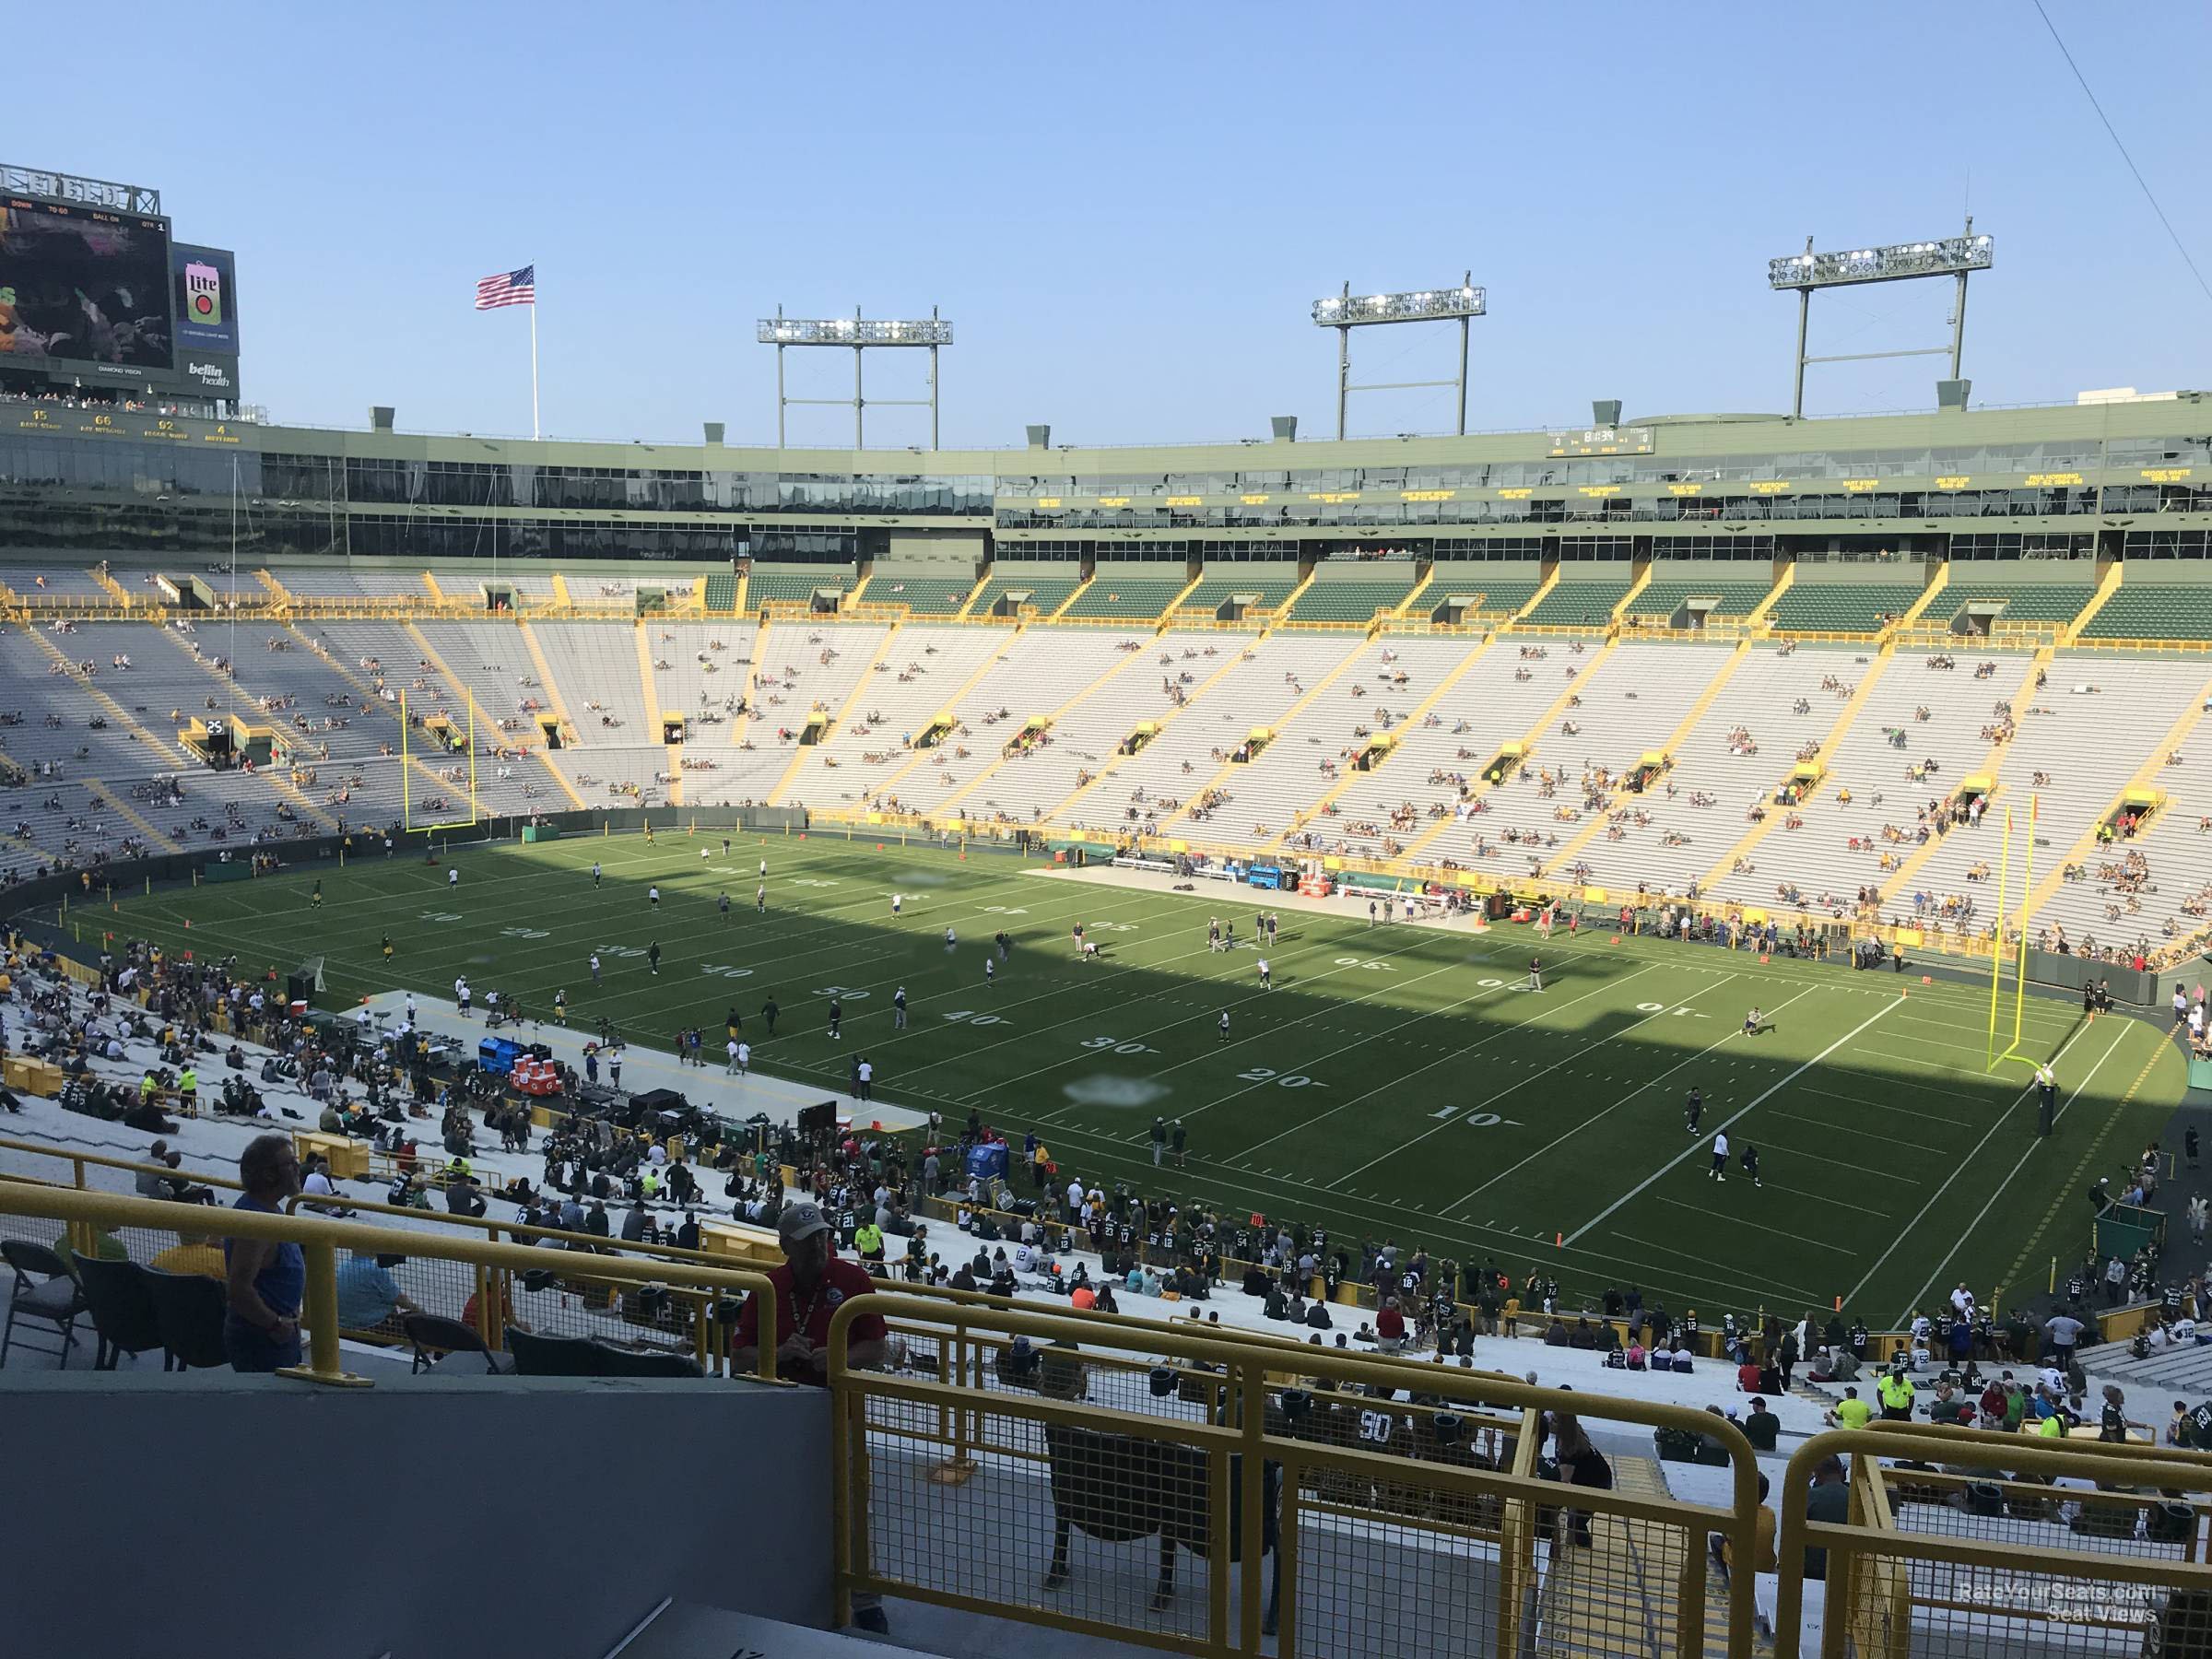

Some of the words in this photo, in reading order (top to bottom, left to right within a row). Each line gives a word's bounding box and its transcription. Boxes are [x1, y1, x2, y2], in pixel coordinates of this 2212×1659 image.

[28, 171, 120, 206] FIELD
[158, 223, 165, 231] 1
[190, 275, 218, 293] Lite
[189, 363, 223, 376] bellin
[202, 375, 229, 387] health
[33, 410, 48, 420] 15
[95, 415, 112, 426] 66
[158, 419, 173, 430] 92
[218, 425, 225, 434] 4
[1555, 438, 1560, 446] 0
[1642, 434, 1648, 442] 0
[207, 720, 223, 734] 25
[811, 985, 871, 1000] 50
[1636, 1003, 1696, 1017] 10
[942, 1010, 1002, 1025] 40
[1080, 1037, 1147, 1053] 30
[1236, 1068, 1311, 1088] 20
[1427, 1106, 1501, 1126] 10
[842, 1217, 855, 1228] 21
[1253, 1216, 1263, 1225] 10
[1105, 1227, 1113, 1236] 23
[1120, 1231, 1130, 1242] 17
[1061, 1240, 1068, 1249] 12
[1164, 1238, 1173, 1248] 12
[1237, 1239, 1247, 1247] 54
[1016, 1249, 1027, 1261] 12
[1283, 1262, 1292, 1273] 12
[1072, 1271, 1081, 1280] 18
[1328, 1275, 1335, 1286] 4
[1047, 1280, 1056, 1291] 21
[1403, 1277, 1413, 1288] 18
[1548, 1287, 1557, 1296] 12
[2071, 1285, 2080, 1294] 12
[1439, 1303, 1451, 1315] 52
[1687, 1322, 1697, 1331] 12
[1673, 1328, 1681, 1337] 18
[2183, 1327, 2194, 1338] 12
[1854, 1334, 1866, 1346] 27
[1900, 1357, 1909, 1368] 12
[1919, 1355, 1929, 1364] 52
[2053, 1375, 2062, 1390] 4
[1359, 1408, 1393, 1443] 90
